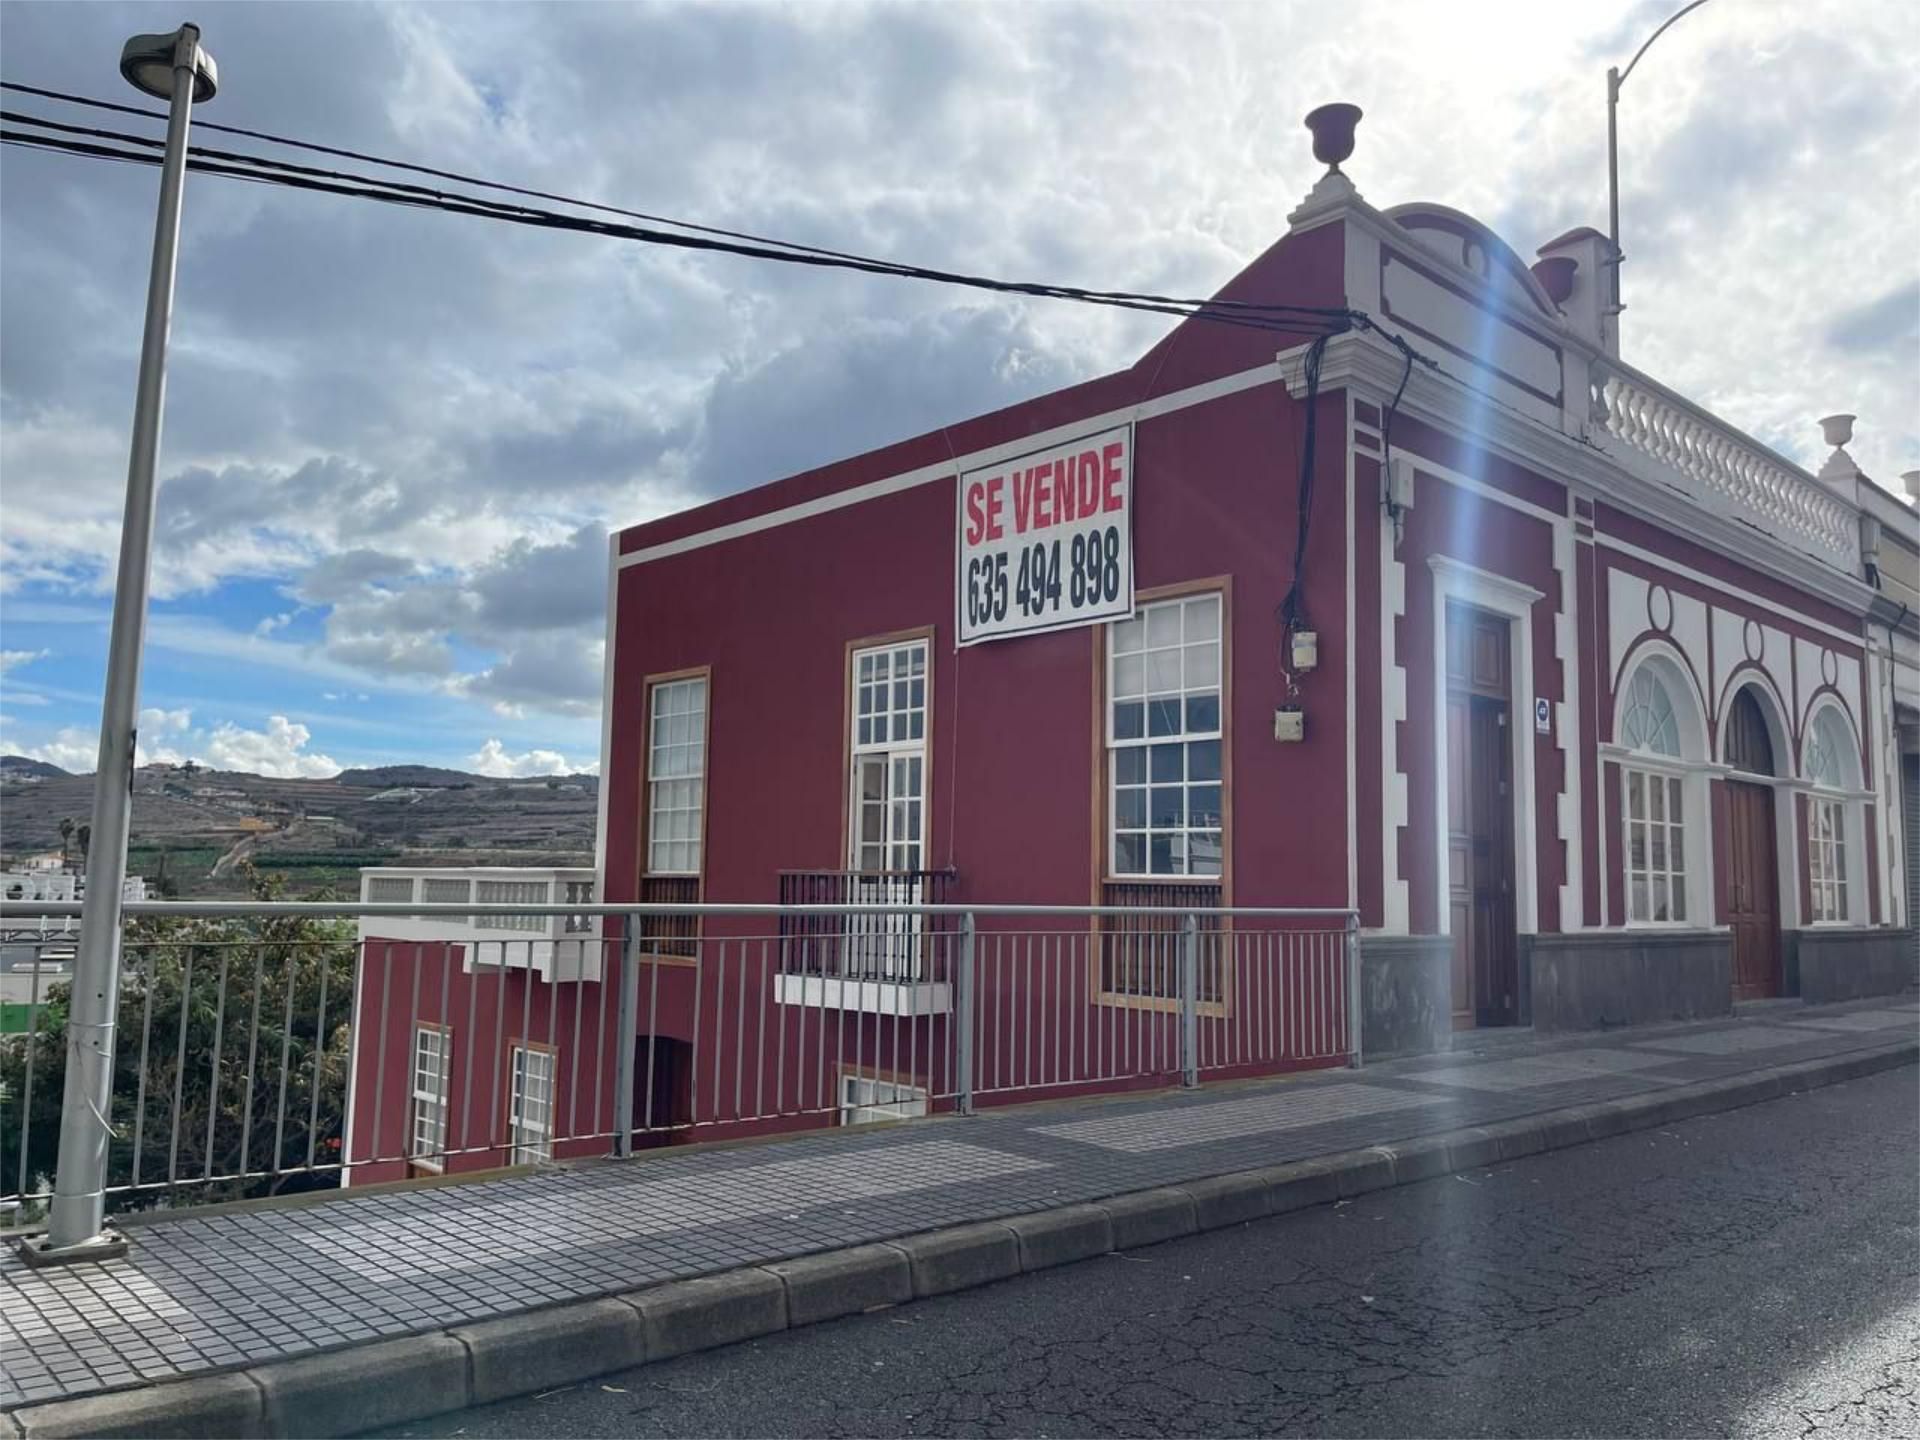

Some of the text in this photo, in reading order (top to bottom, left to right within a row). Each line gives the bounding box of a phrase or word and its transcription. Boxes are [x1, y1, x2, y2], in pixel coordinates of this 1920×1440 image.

[966, 441, 1123, 546] SE VENDE
[968, 525, 1120, 627] 635 494 898
